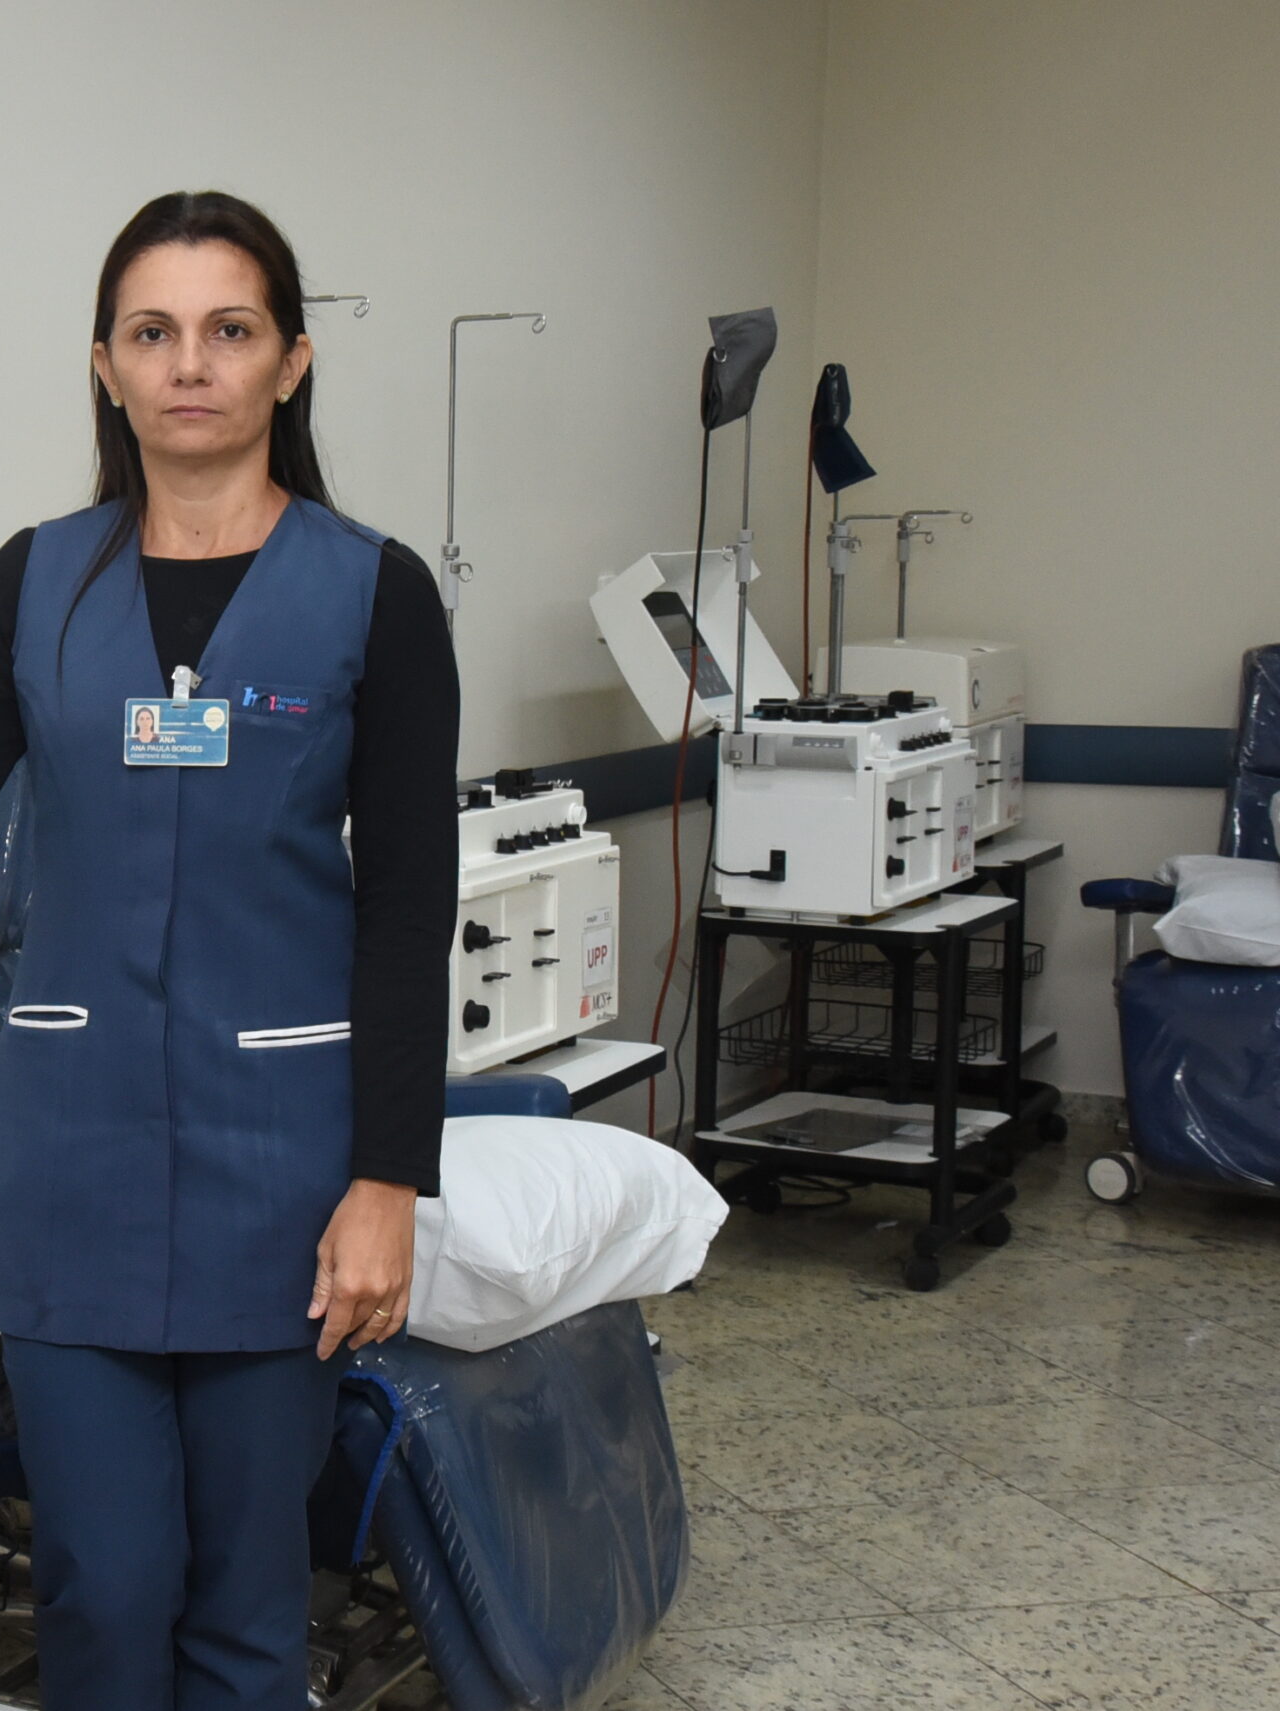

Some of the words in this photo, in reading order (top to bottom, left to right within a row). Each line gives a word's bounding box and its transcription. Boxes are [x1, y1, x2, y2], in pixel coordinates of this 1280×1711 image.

[159, 736, 176, 744] ANA
[171, 745, 203, 753] BORGES
[587, 944, 608, 968] UPP
